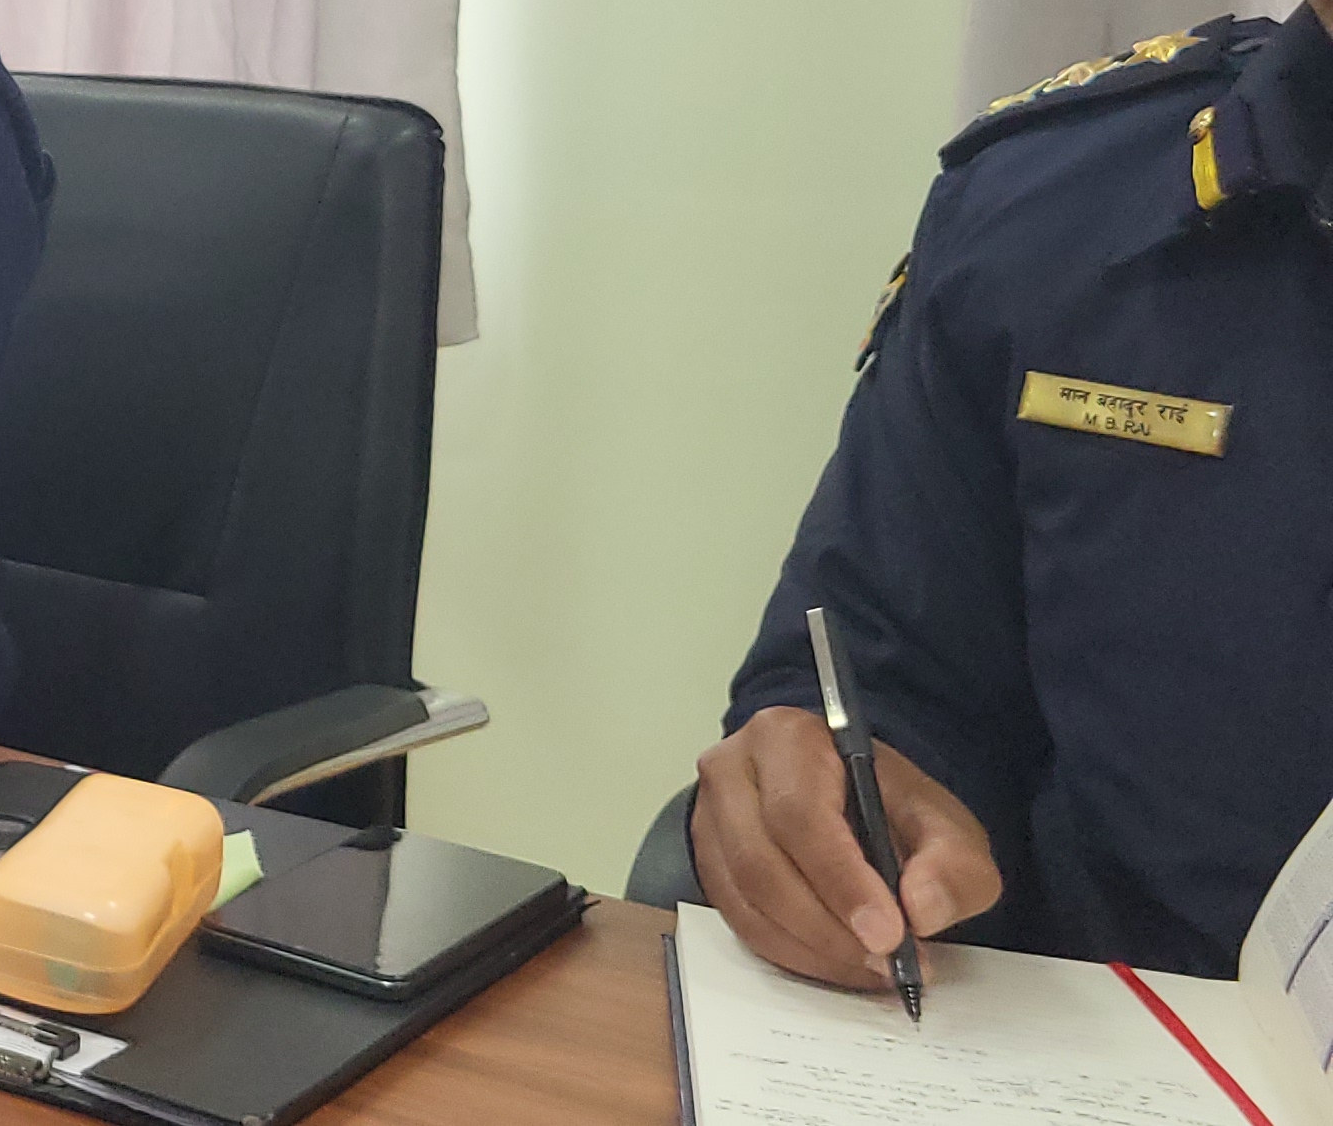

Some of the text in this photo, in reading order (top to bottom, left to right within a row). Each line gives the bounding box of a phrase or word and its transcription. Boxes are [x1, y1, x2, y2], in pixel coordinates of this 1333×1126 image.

[1059, 386, 1091, 405] मान
[1097, 393, 1148, 419] बहादुर
[1123, 420, 1151, 436] RAI
